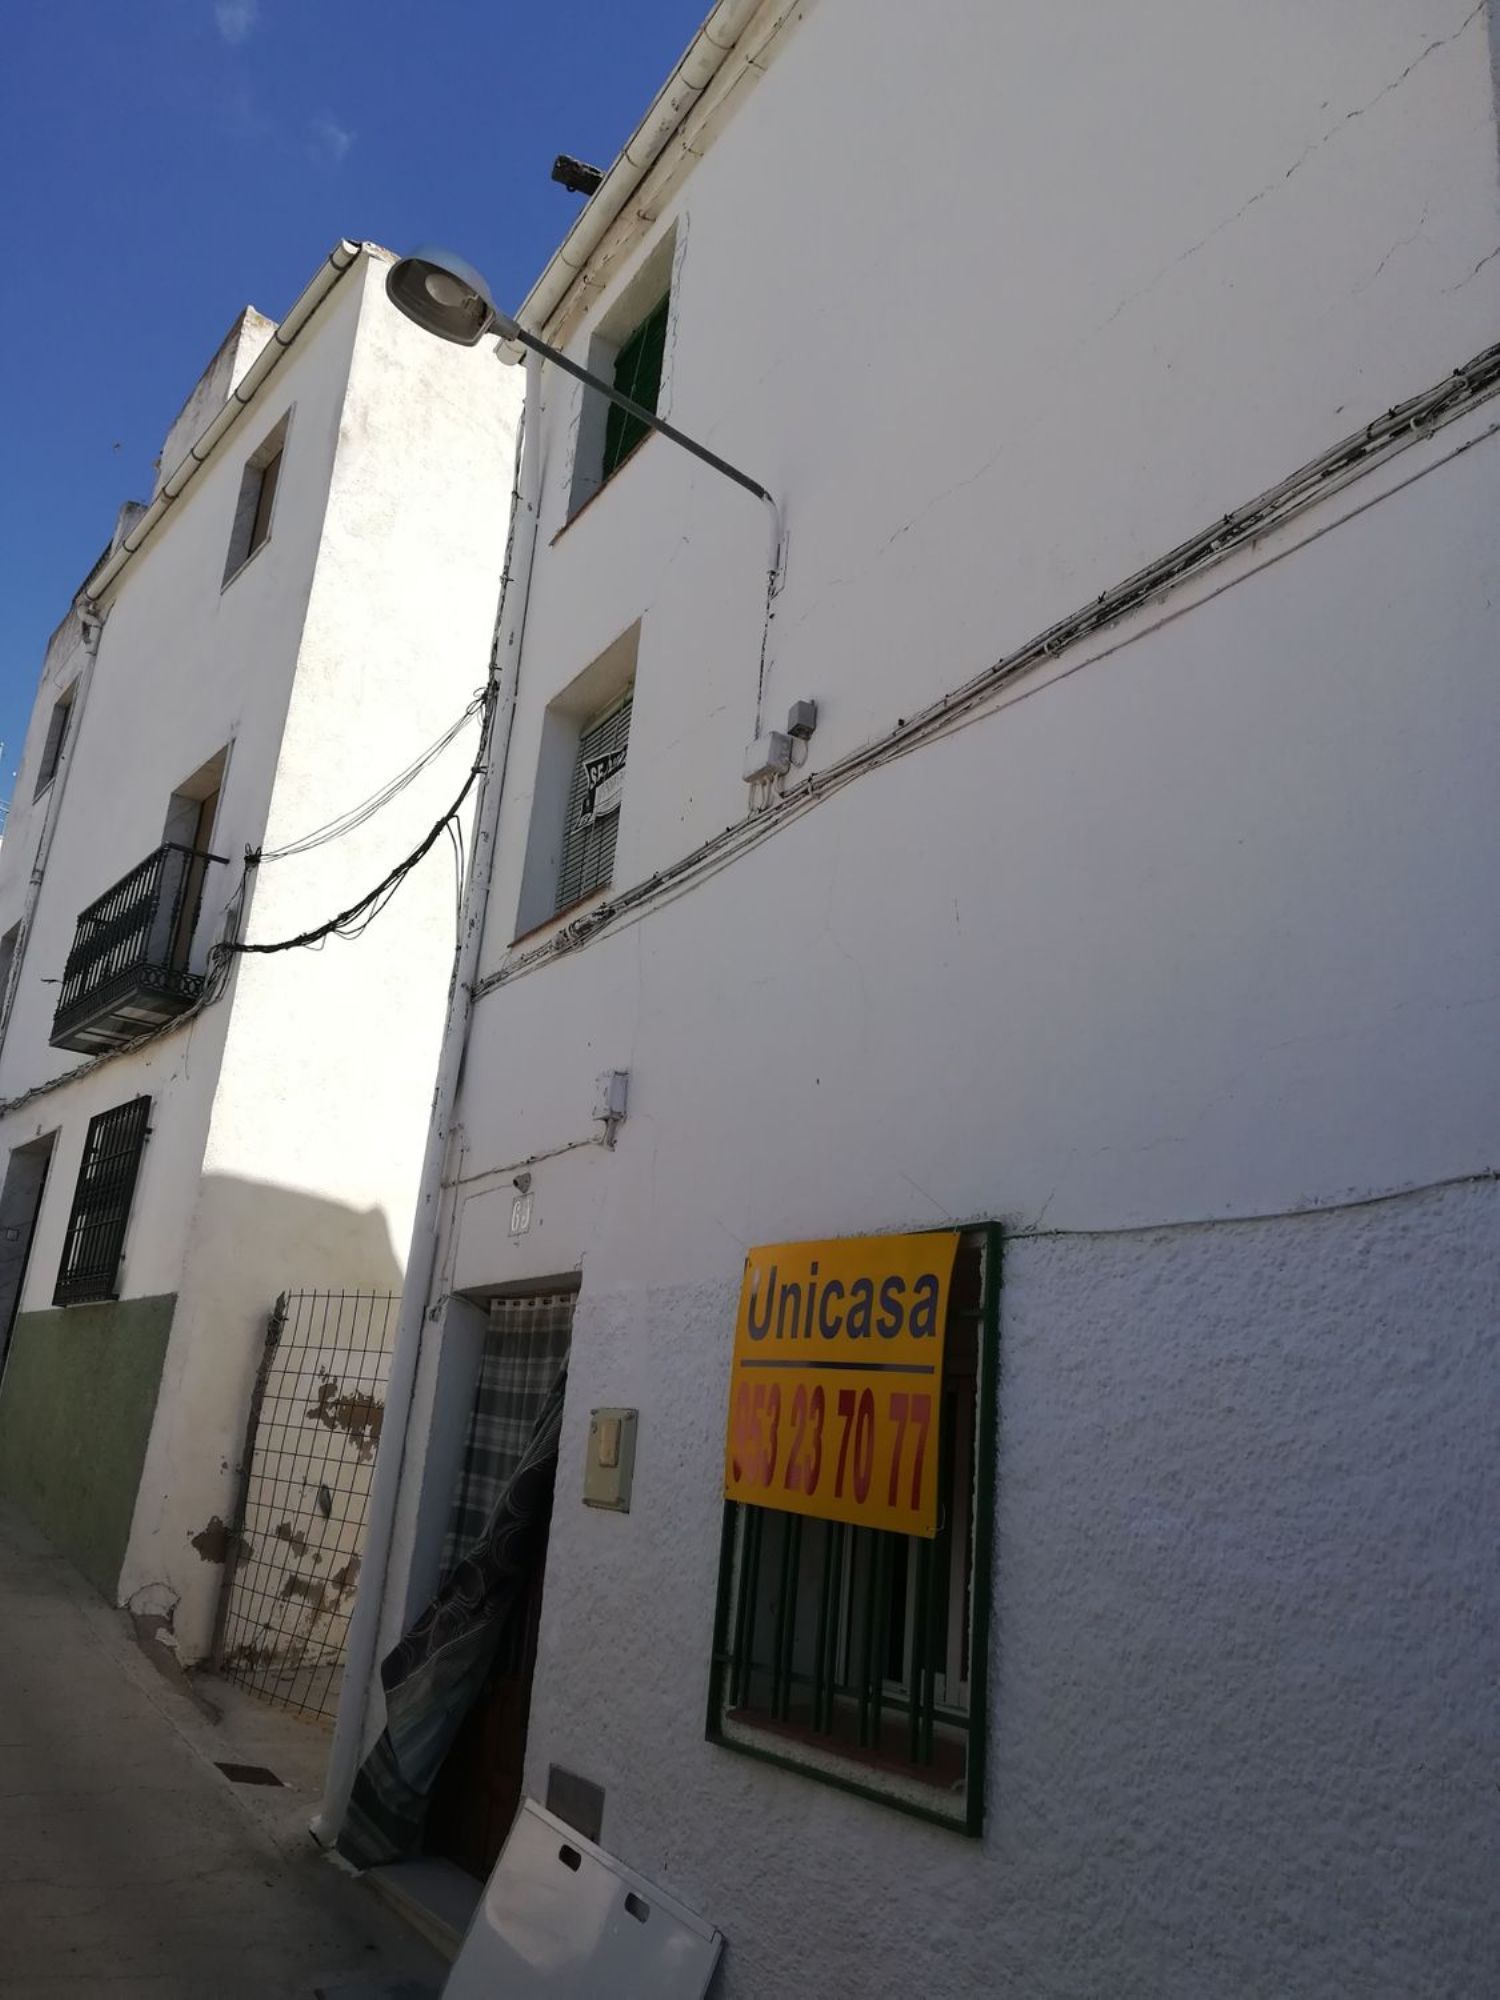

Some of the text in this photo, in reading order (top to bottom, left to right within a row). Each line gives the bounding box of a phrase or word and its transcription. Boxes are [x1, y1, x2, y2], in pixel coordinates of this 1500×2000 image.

[747, 1261, 940, 1341] Unicasa
[732, 1381, 933, 1512] 953 23 70 77
